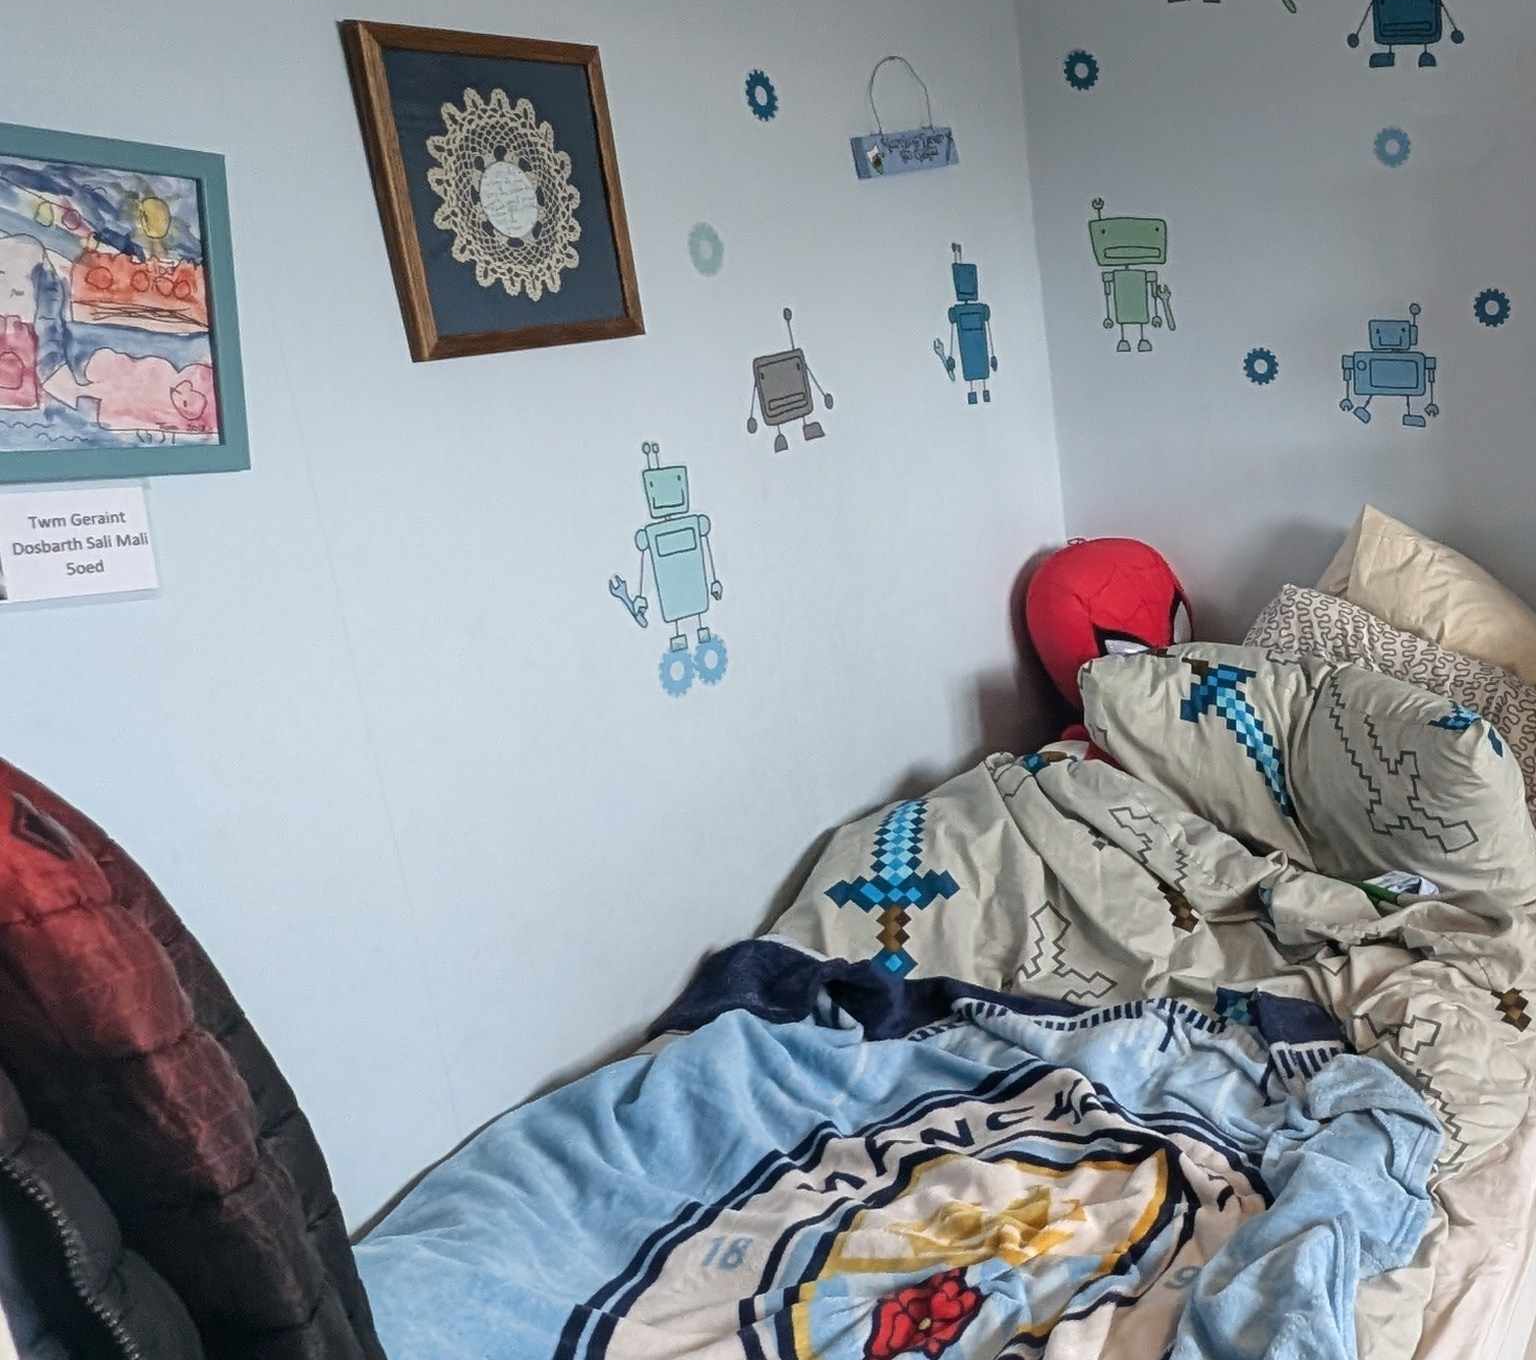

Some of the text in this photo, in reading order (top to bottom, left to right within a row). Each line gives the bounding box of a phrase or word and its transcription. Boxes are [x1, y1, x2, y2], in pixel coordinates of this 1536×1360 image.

[27, 511, 127, 530] Twm Geraint
[12, 532, 150, 556] Dosbarth Sali Mali
[702, 1235, 754, 1271] 18
